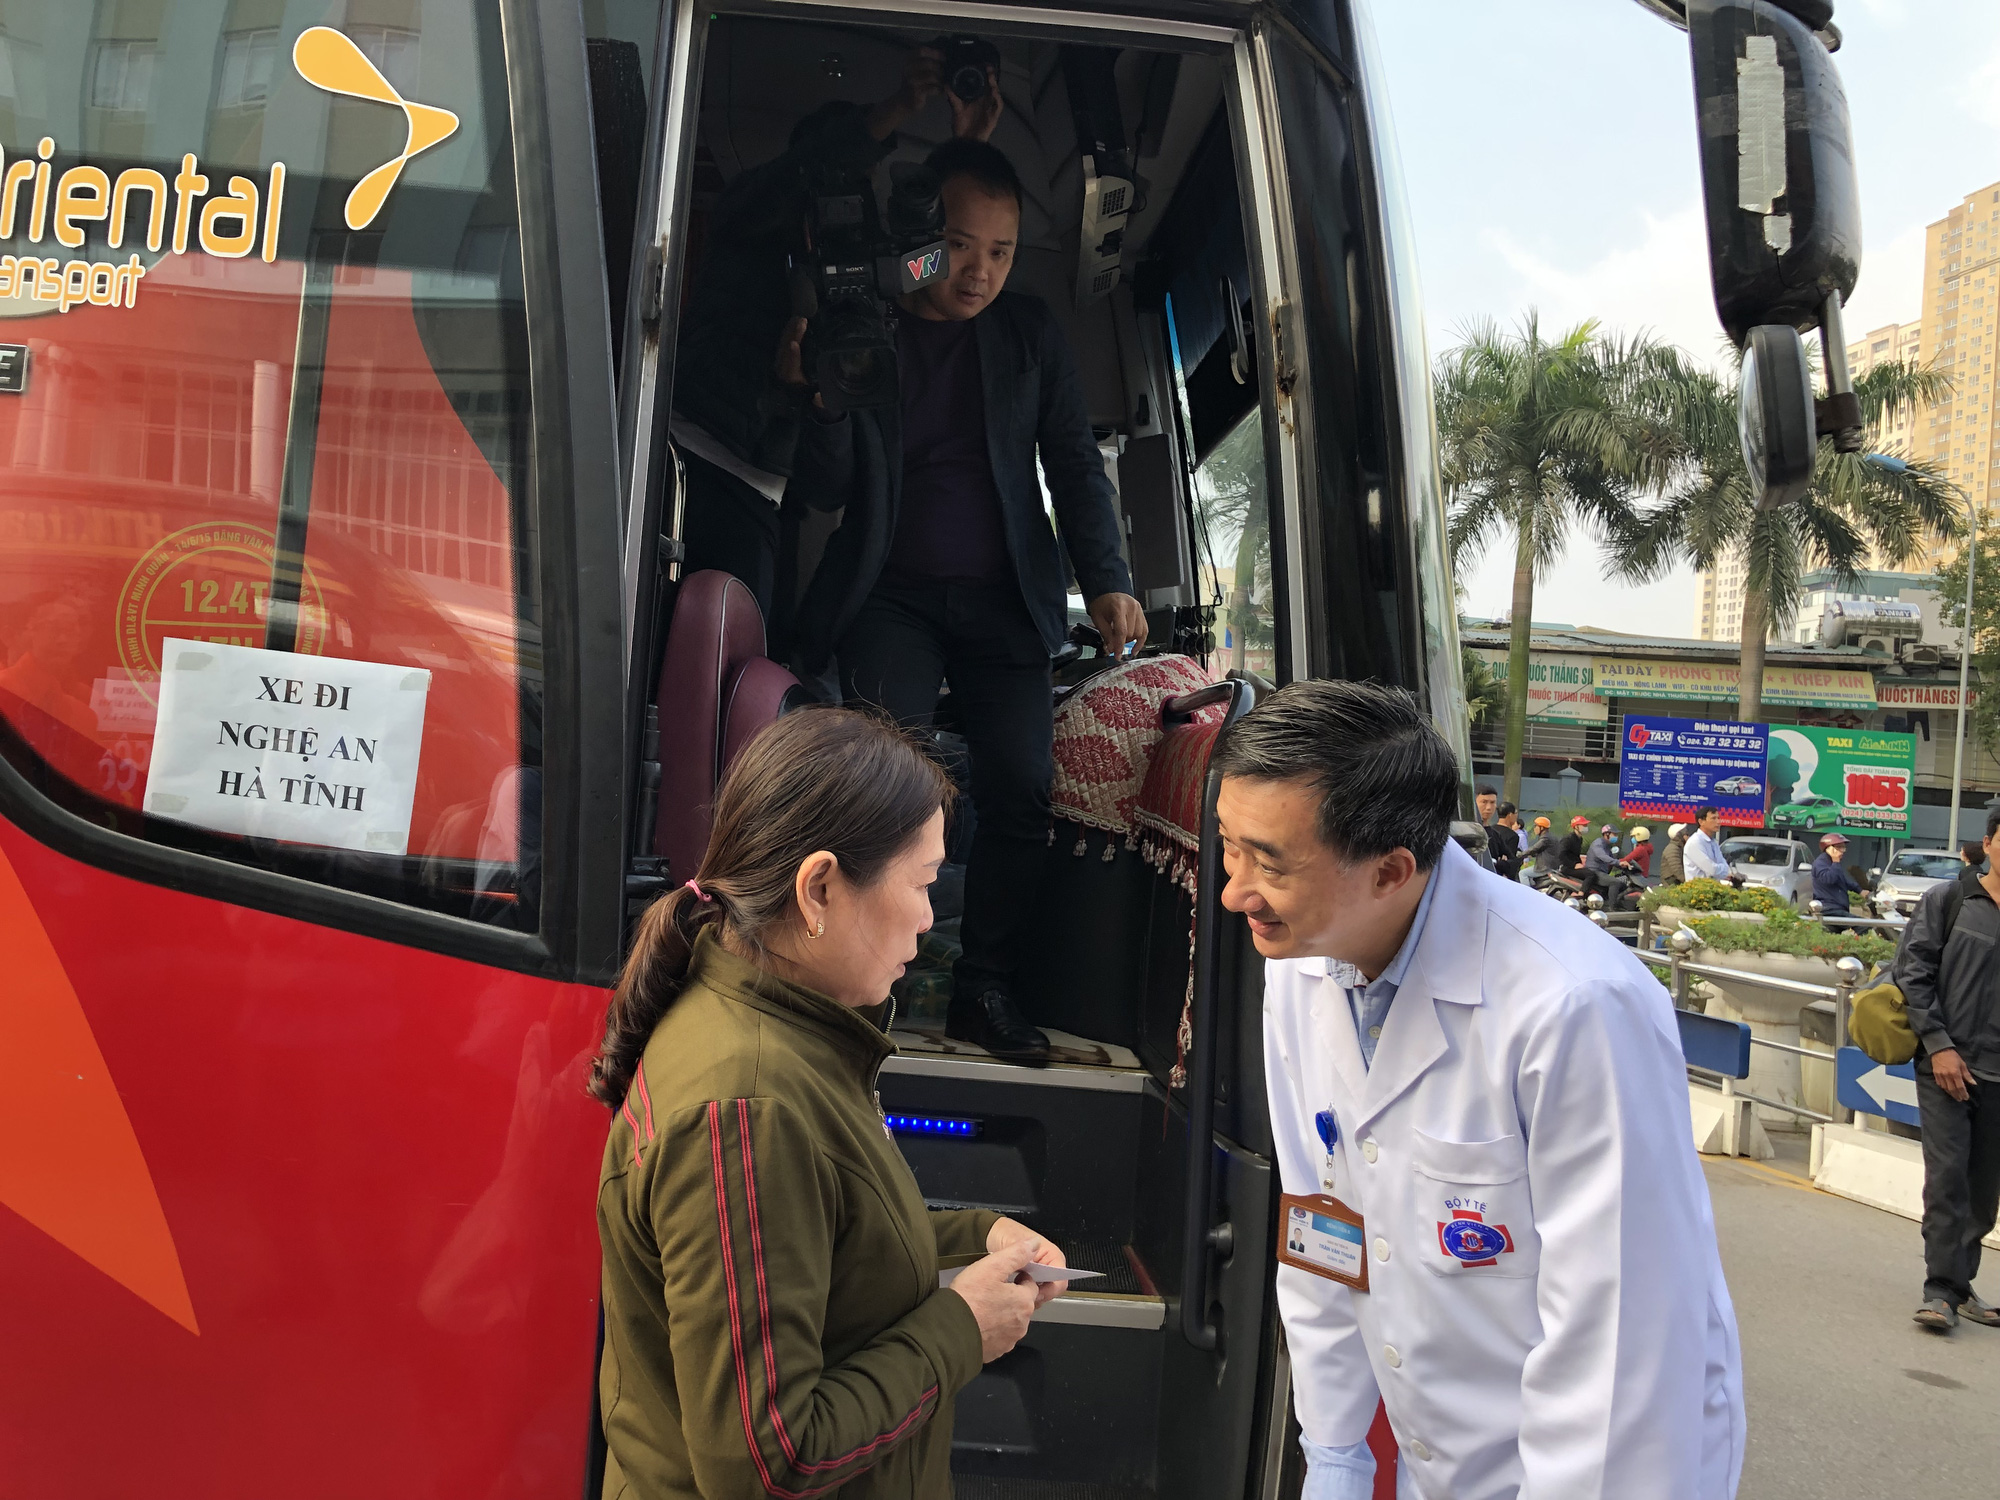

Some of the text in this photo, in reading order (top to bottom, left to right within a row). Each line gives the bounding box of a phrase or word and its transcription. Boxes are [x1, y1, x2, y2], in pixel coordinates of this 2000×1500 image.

[0, 136, 286, 263] riental
[907, 249, 941, 281] VTV
[131, 575, 150, 602] MINH
[181, 579, 269, 615] 12.4T
[126, 602, 139, 635] DL&VT
[128, 637, 142, 663] TNHH
[1528, 654, 1547, 682] UỐC
[1600, 664, 1622, 676] TẠI
[1626, 663, 1653, 676] ĐÂY
[1659, 664, 1712, 681] PHÒNG
[255, 675, 353, 711] XE ĐI
[216, 720, 378, 764] NGHỆ AN
[1629, 724, 1672, 748] G7 TAXI
[1694, 722, 1754, 735] Điện thoại gọi taxi
[1703, 736, 1716, 746] 32
[1718, 737, 1731, 747] 32
[1733, 738, 1746, 748] 32
[1748, 739, 1761, 749] 32
[1827, 737, 1853, 748] TAXI
[216, 766, 367, 812] HÀ TĨNH
[1846, 773, 1907, 808] 1055
[1444, 1195, 1488, 1213] BỘ Y TẾ
